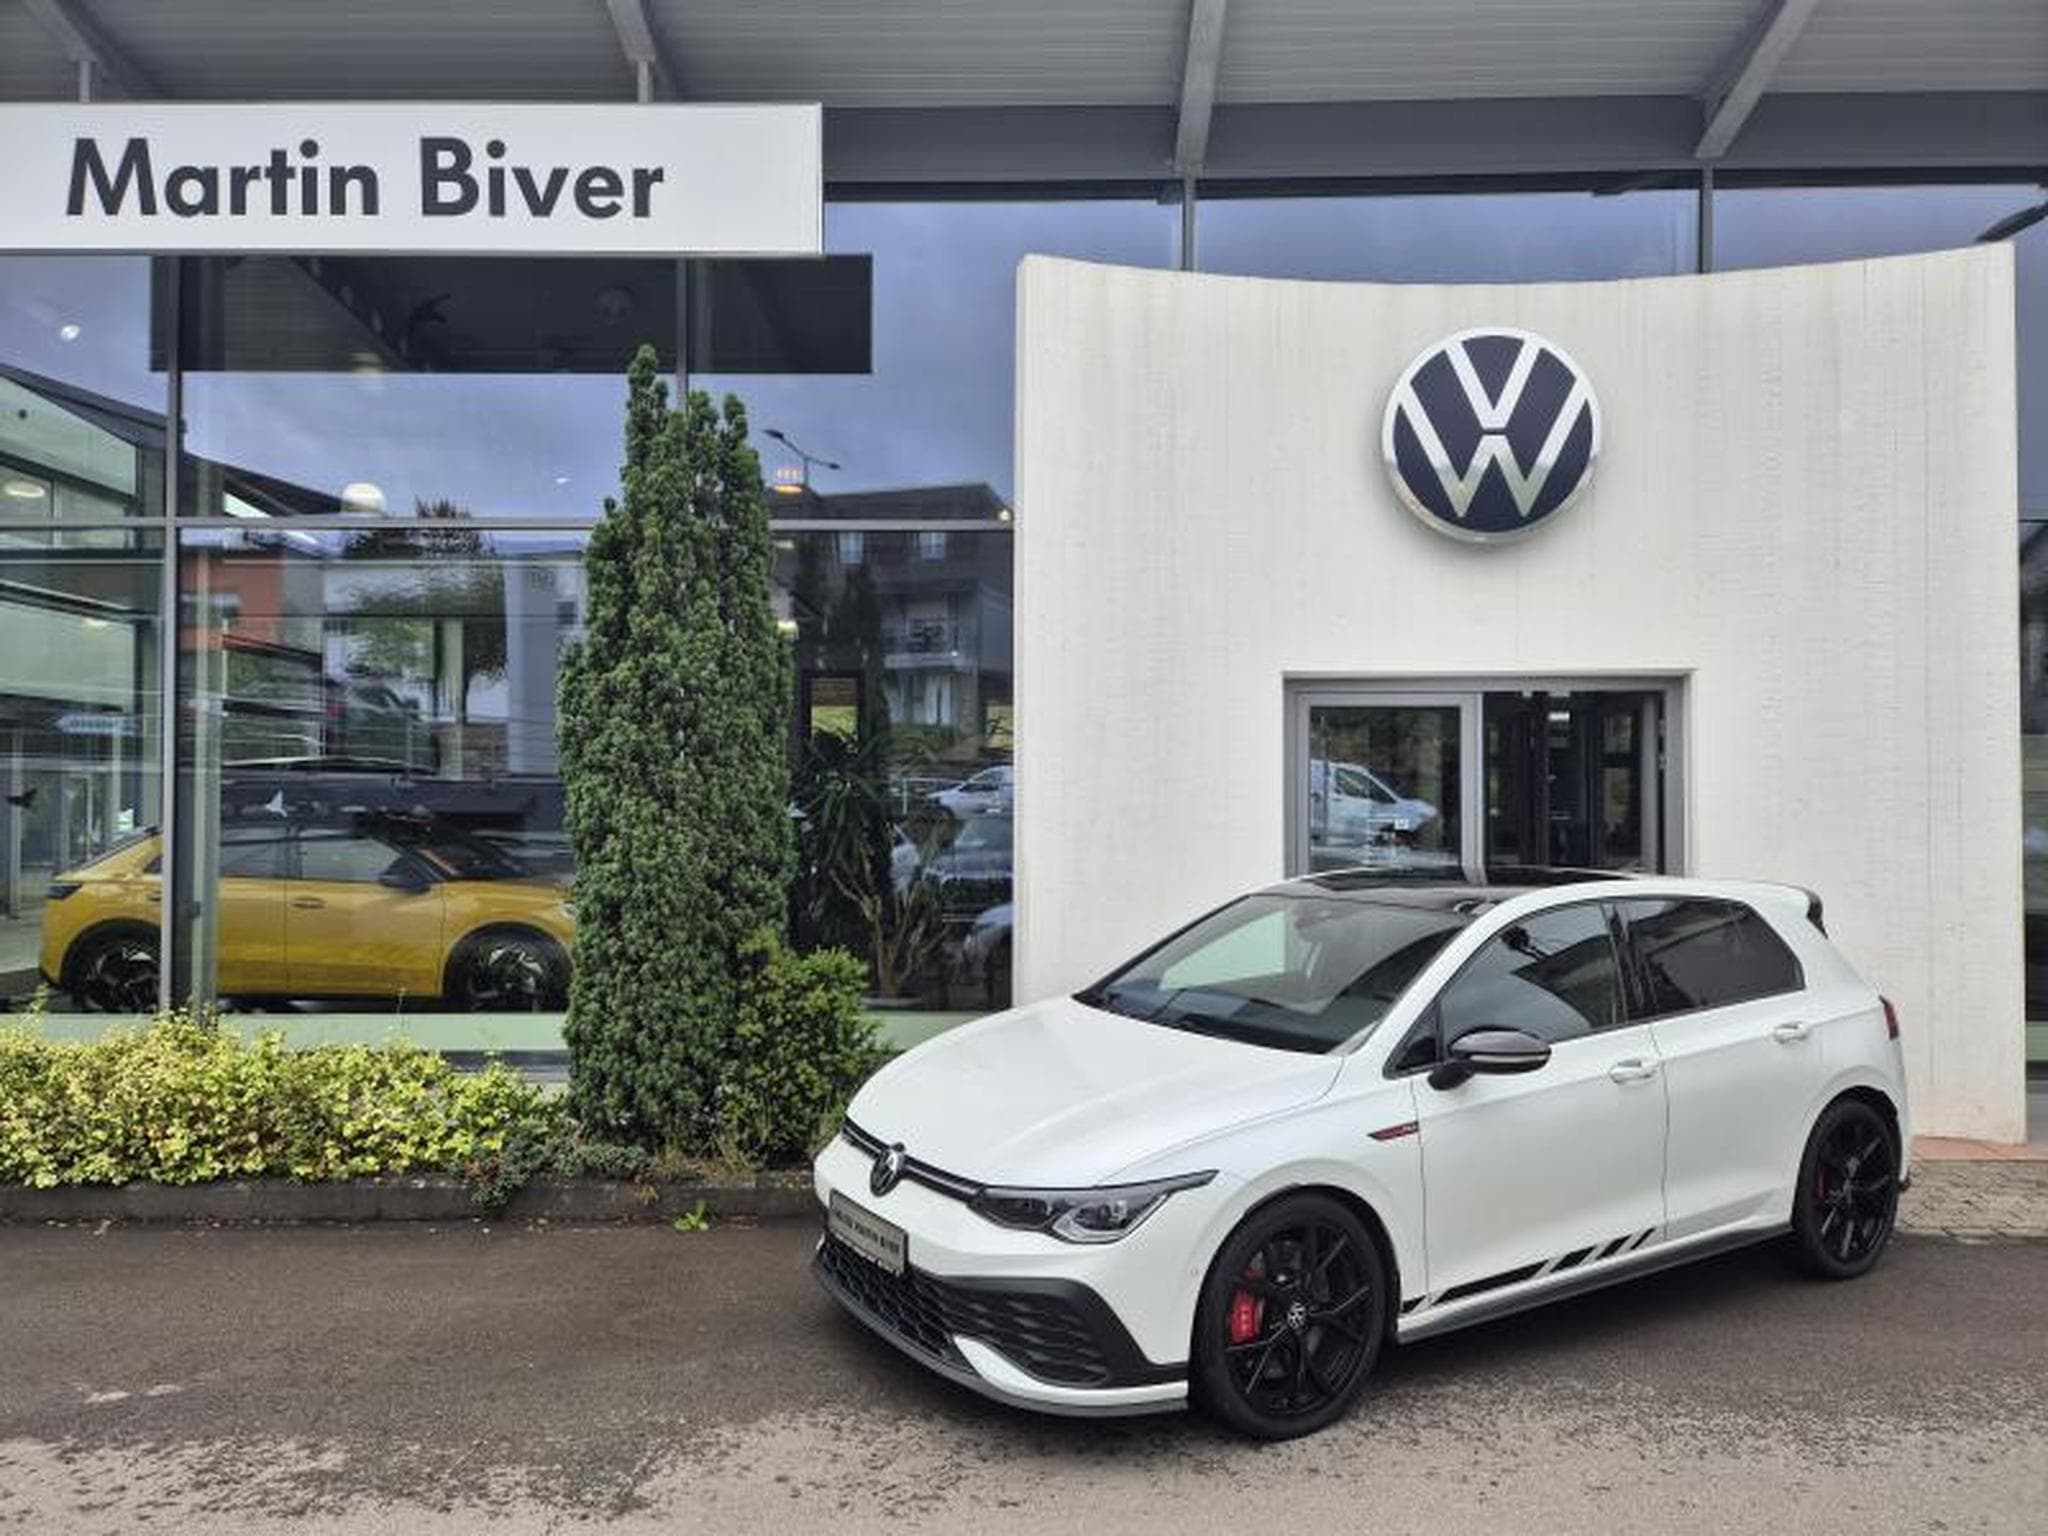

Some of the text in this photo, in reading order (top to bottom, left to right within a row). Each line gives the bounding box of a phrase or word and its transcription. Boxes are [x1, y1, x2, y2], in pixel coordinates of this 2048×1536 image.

[66, 137, 664, 219] Martin Biver
[1391, 332, 1595, 534] VW
